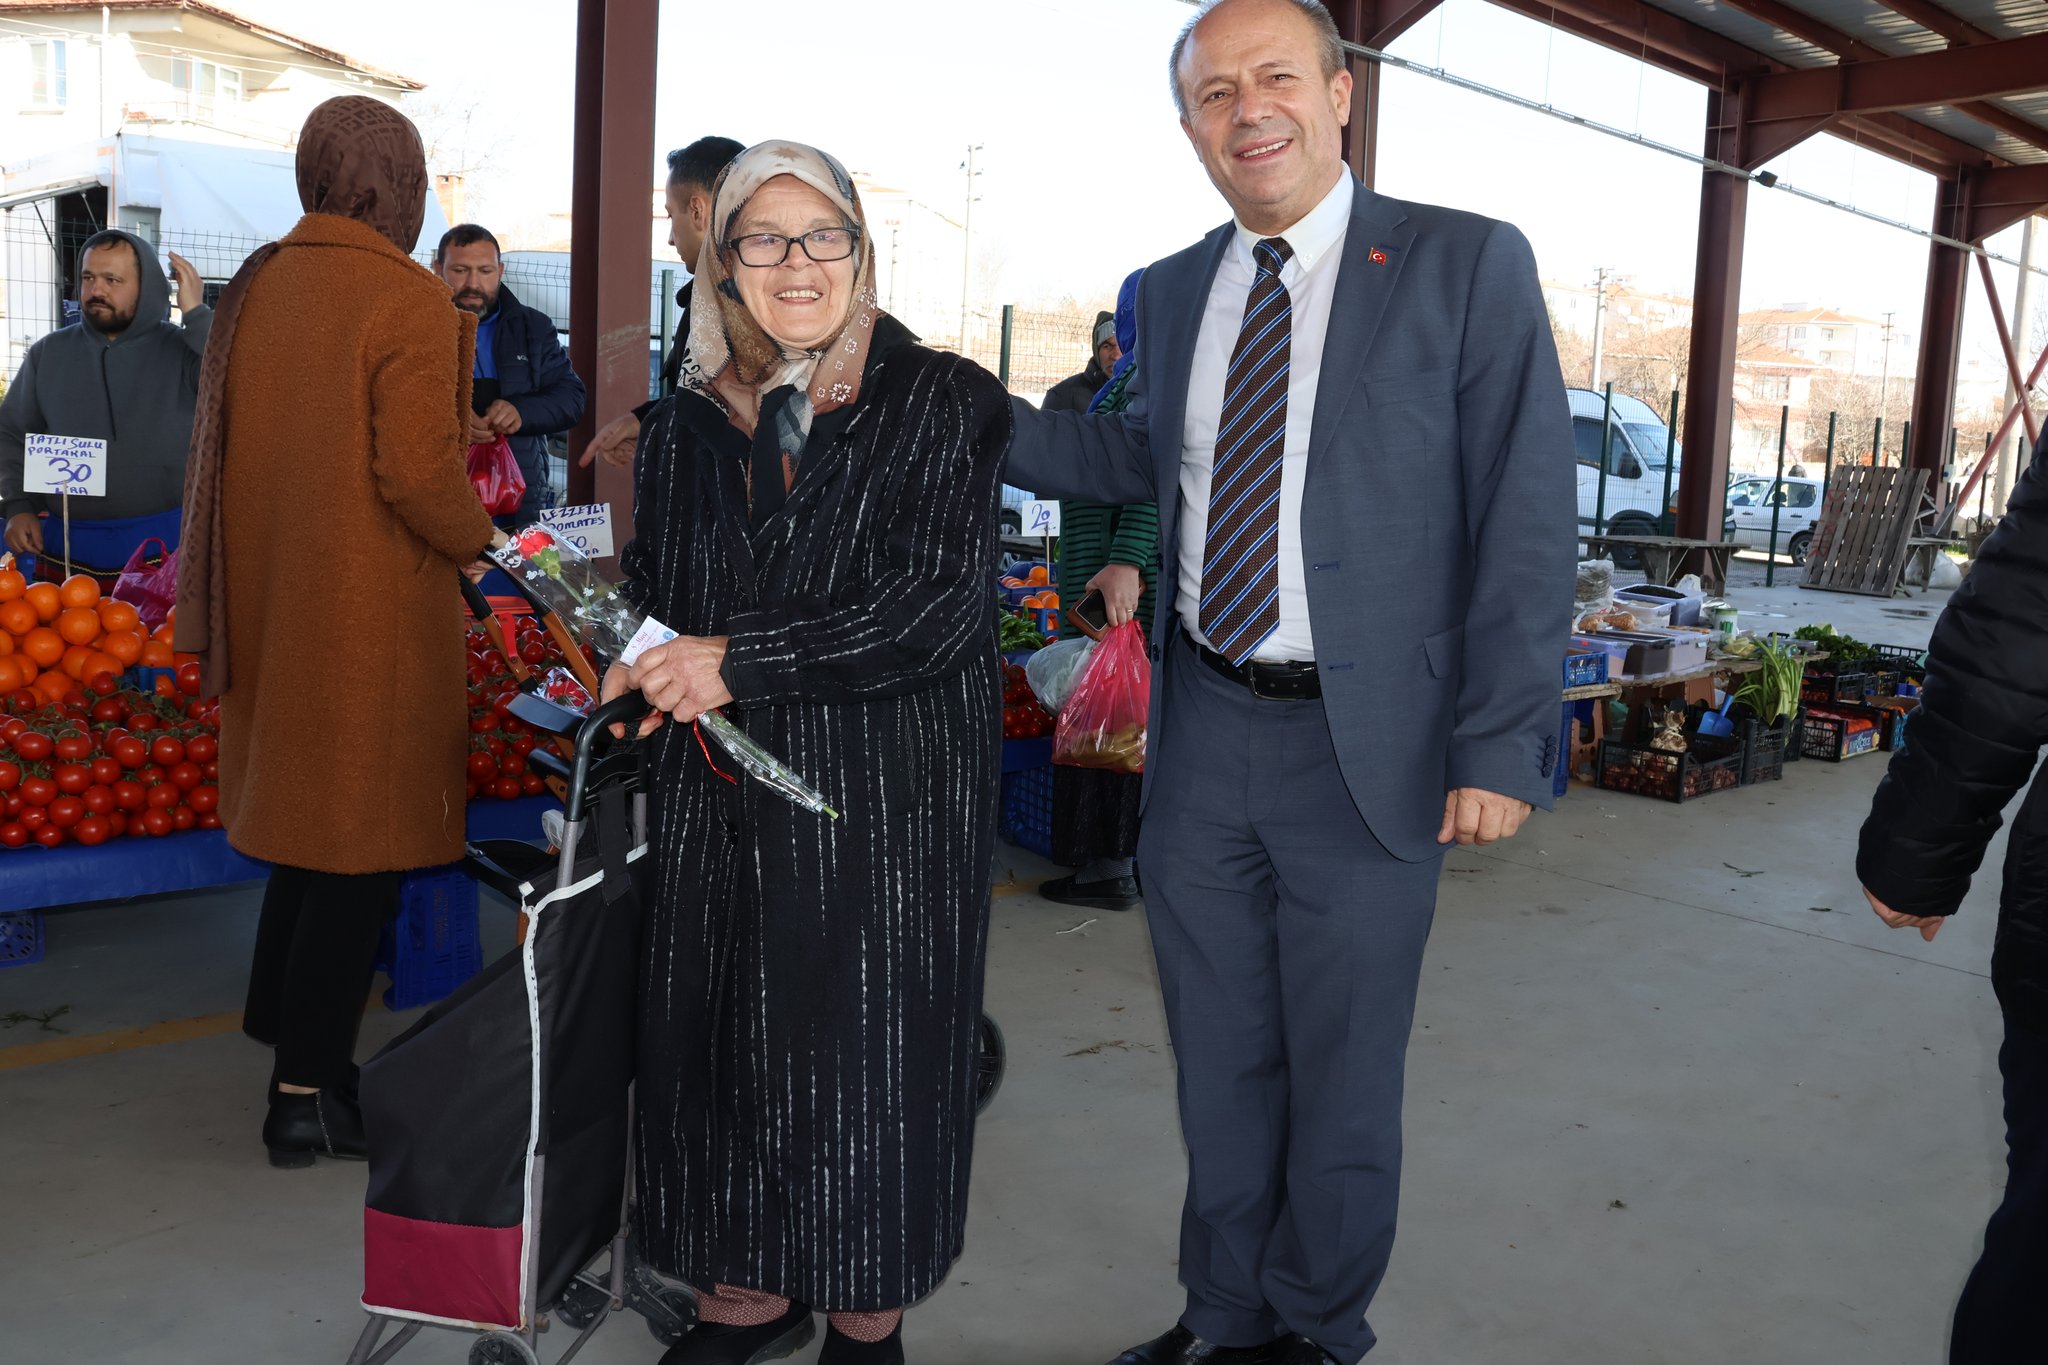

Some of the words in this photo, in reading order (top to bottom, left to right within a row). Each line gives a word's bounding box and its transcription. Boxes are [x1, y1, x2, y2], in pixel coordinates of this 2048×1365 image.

[26, 434, 67, 445] TATLI
[67, 438, 104, 450] SULU
[28, 447, 97, 459] PORTAKAL
[45, 457, 92, 485] 30
[55, 486, 89, 495] LRA
[1031, 503, 1051, 531] 20
